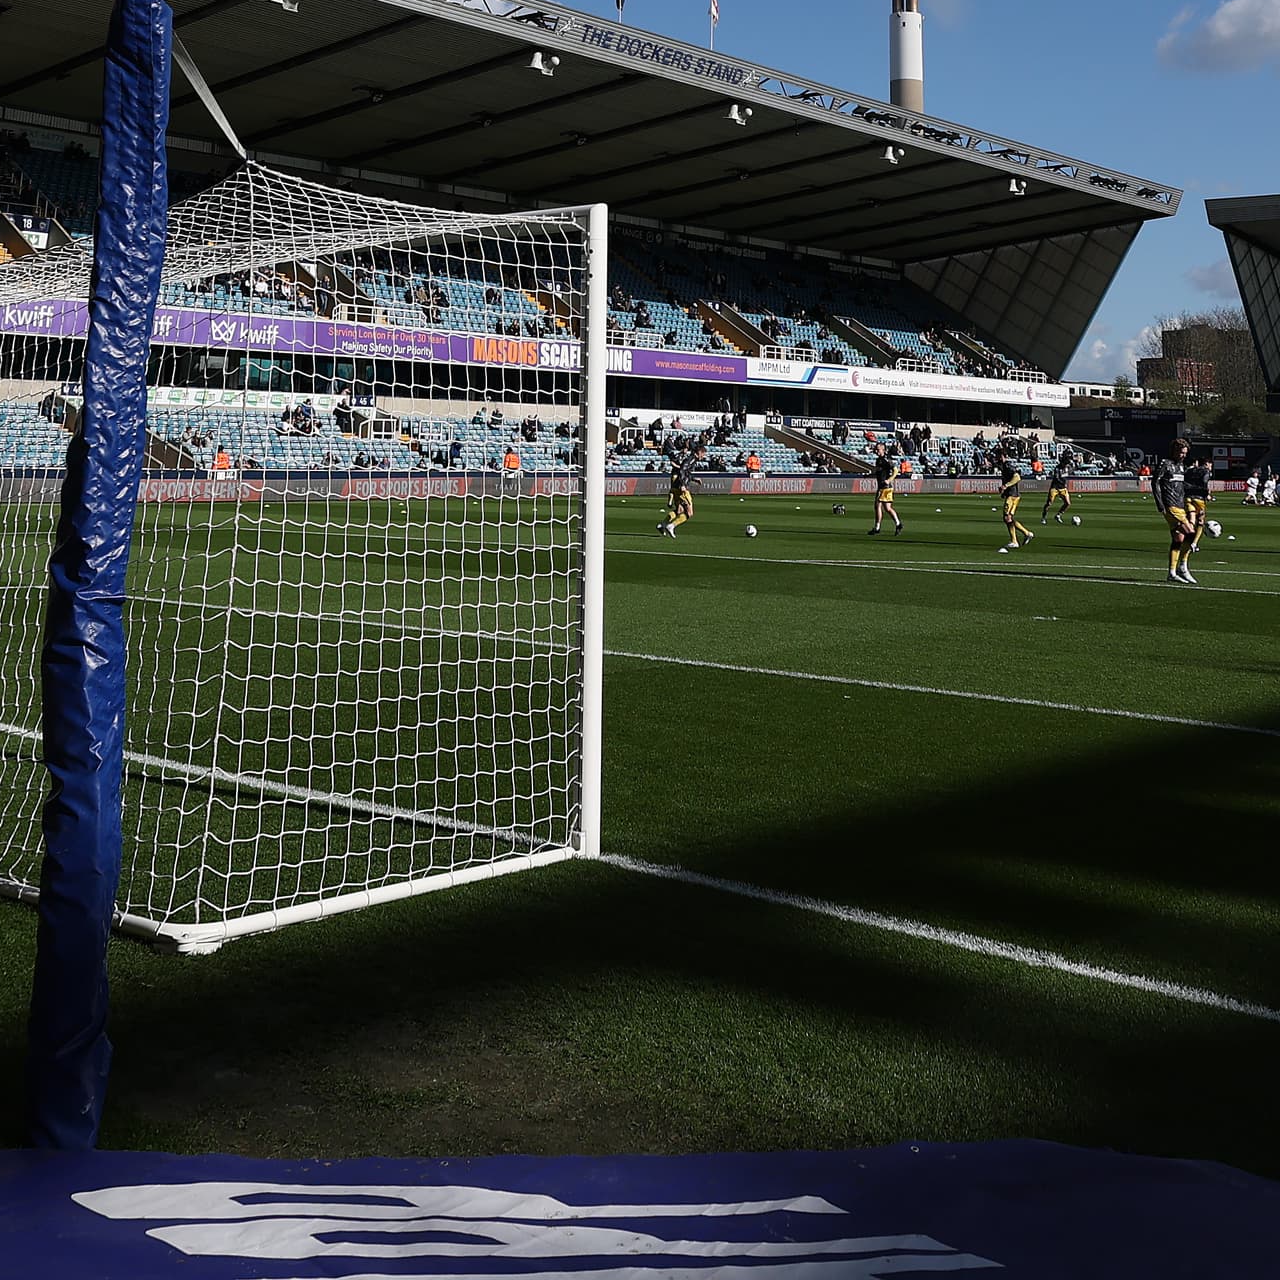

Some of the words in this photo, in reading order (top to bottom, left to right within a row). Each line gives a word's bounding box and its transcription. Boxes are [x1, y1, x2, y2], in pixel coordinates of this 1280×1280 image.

[581, 24, 615, 49] THE
[615, 34, 693, 71] DOCKERS
[694, 58, 744, 85] STAND
[23, 218, 33, 229] 18
[4, 305, 55, 328] kwiff
[153, 315, 173, 336] iff
[240, 323, 280, 343] kwiff
[328, 326, 356, 339] Serving
[358, 328, 386, 340] London
[387, 331, 399, 341] For
[400, 332, 416, 342] Over
[341, 341, 368, 352] Making
[369, 343, 392, 355] Safety
[394, 344, 406, 354] Our
[407, 346, 433, 358] Priority
[473, 337, 538, 365] MASONS
[539, 345, 633, 372] SCAFING
[758, 361, 779, 373] JMPM
[779, 363, 791, 374] Ltd
[862, 375, 905, 388] InsureEasy.co.uk
[149, 479, 201, 501] SPORTS
[355, 479, 378, 497] FOR
[379, 479, 420, 496] SPORTS
[422, 479, 459, 496] EVENTS
[542, 479, 561, 493] FOR
[608, 479, 627, 493] ENTS
[740, 480, 755, 492] FOR
[756, 480, 782, 492] SPORTS
[783, 480, 806, 492] EVENTS
